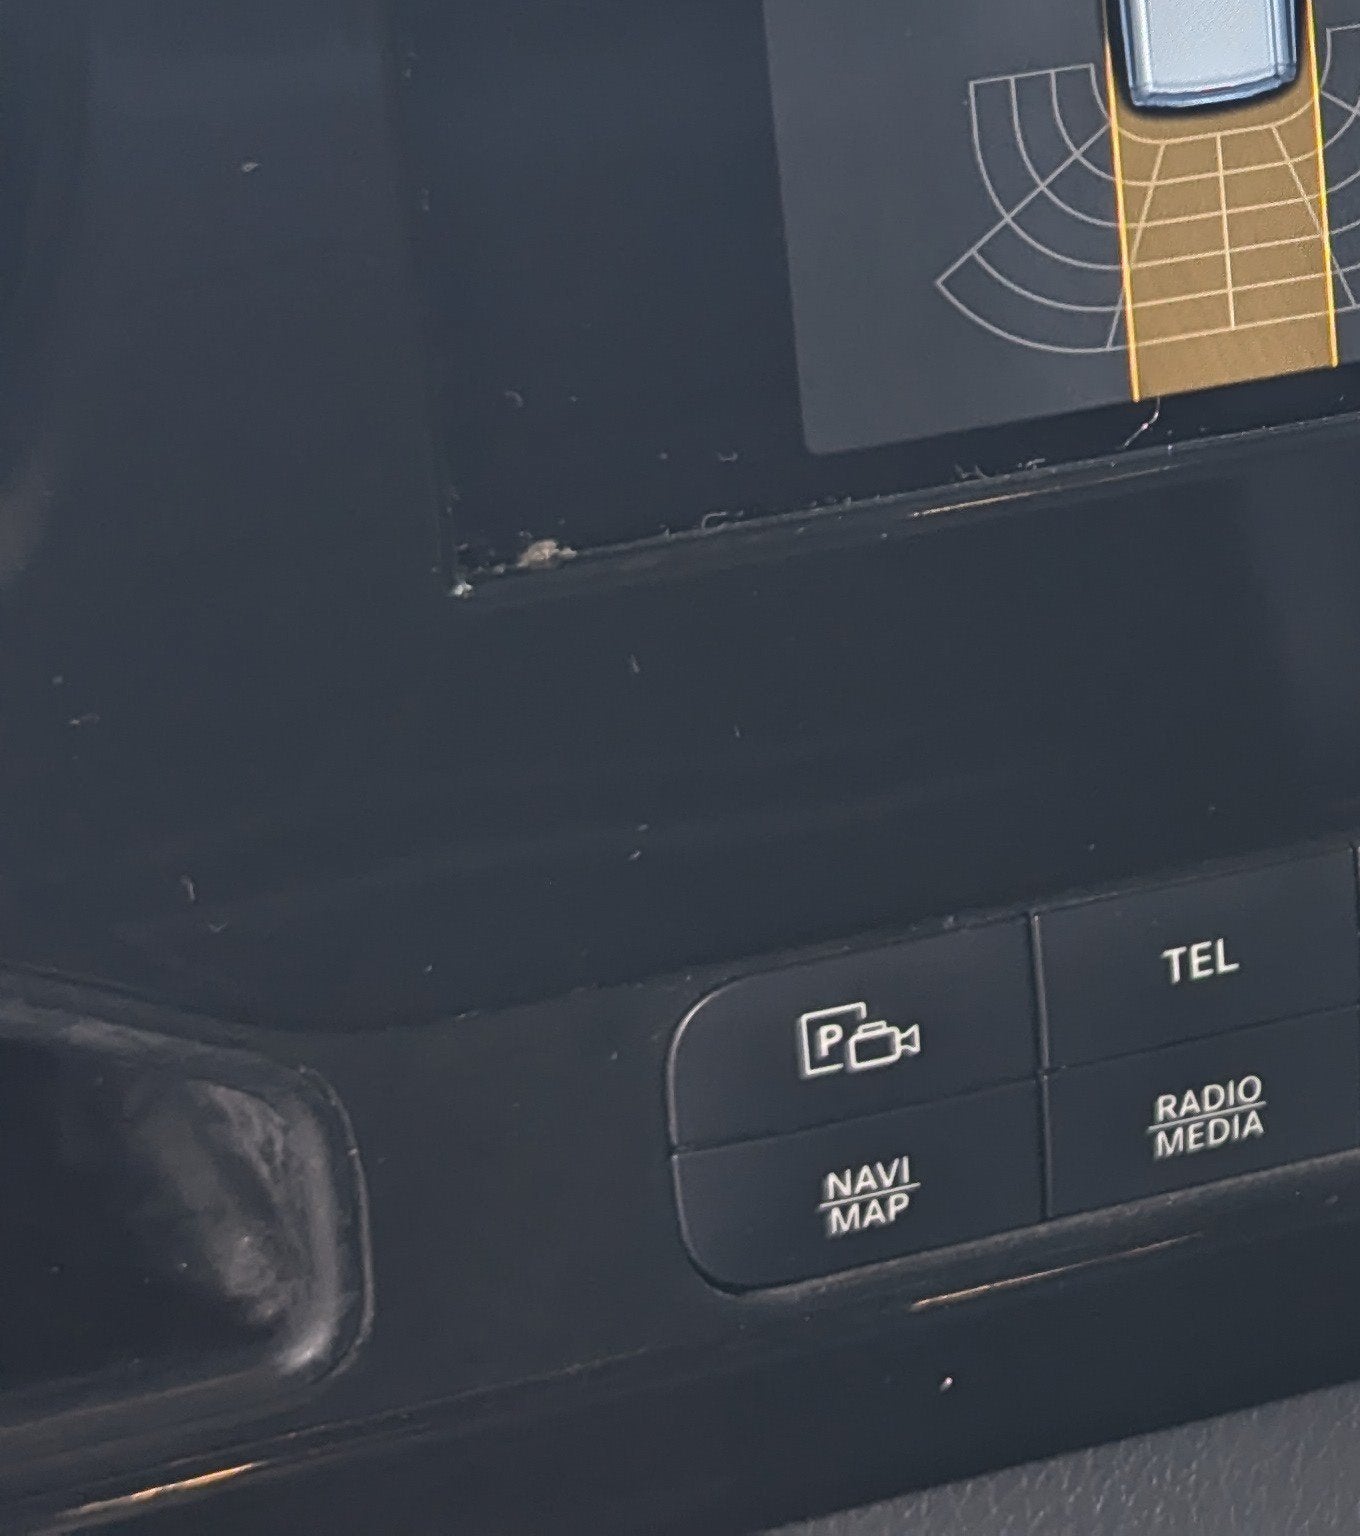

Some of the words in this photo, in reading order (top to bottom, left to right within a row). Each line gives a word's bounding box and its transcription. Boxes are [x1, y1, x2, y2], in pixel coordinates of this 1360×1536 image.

[1161, 938, 1240, 984] TEL
[1154, 1075, 1263, 1123] RADIO
[1153, 1109, 1265, 1159] MEDIA
[825, 1155, 911, 1200] NAVI
[828, 1194, 911, 1237] MAP
